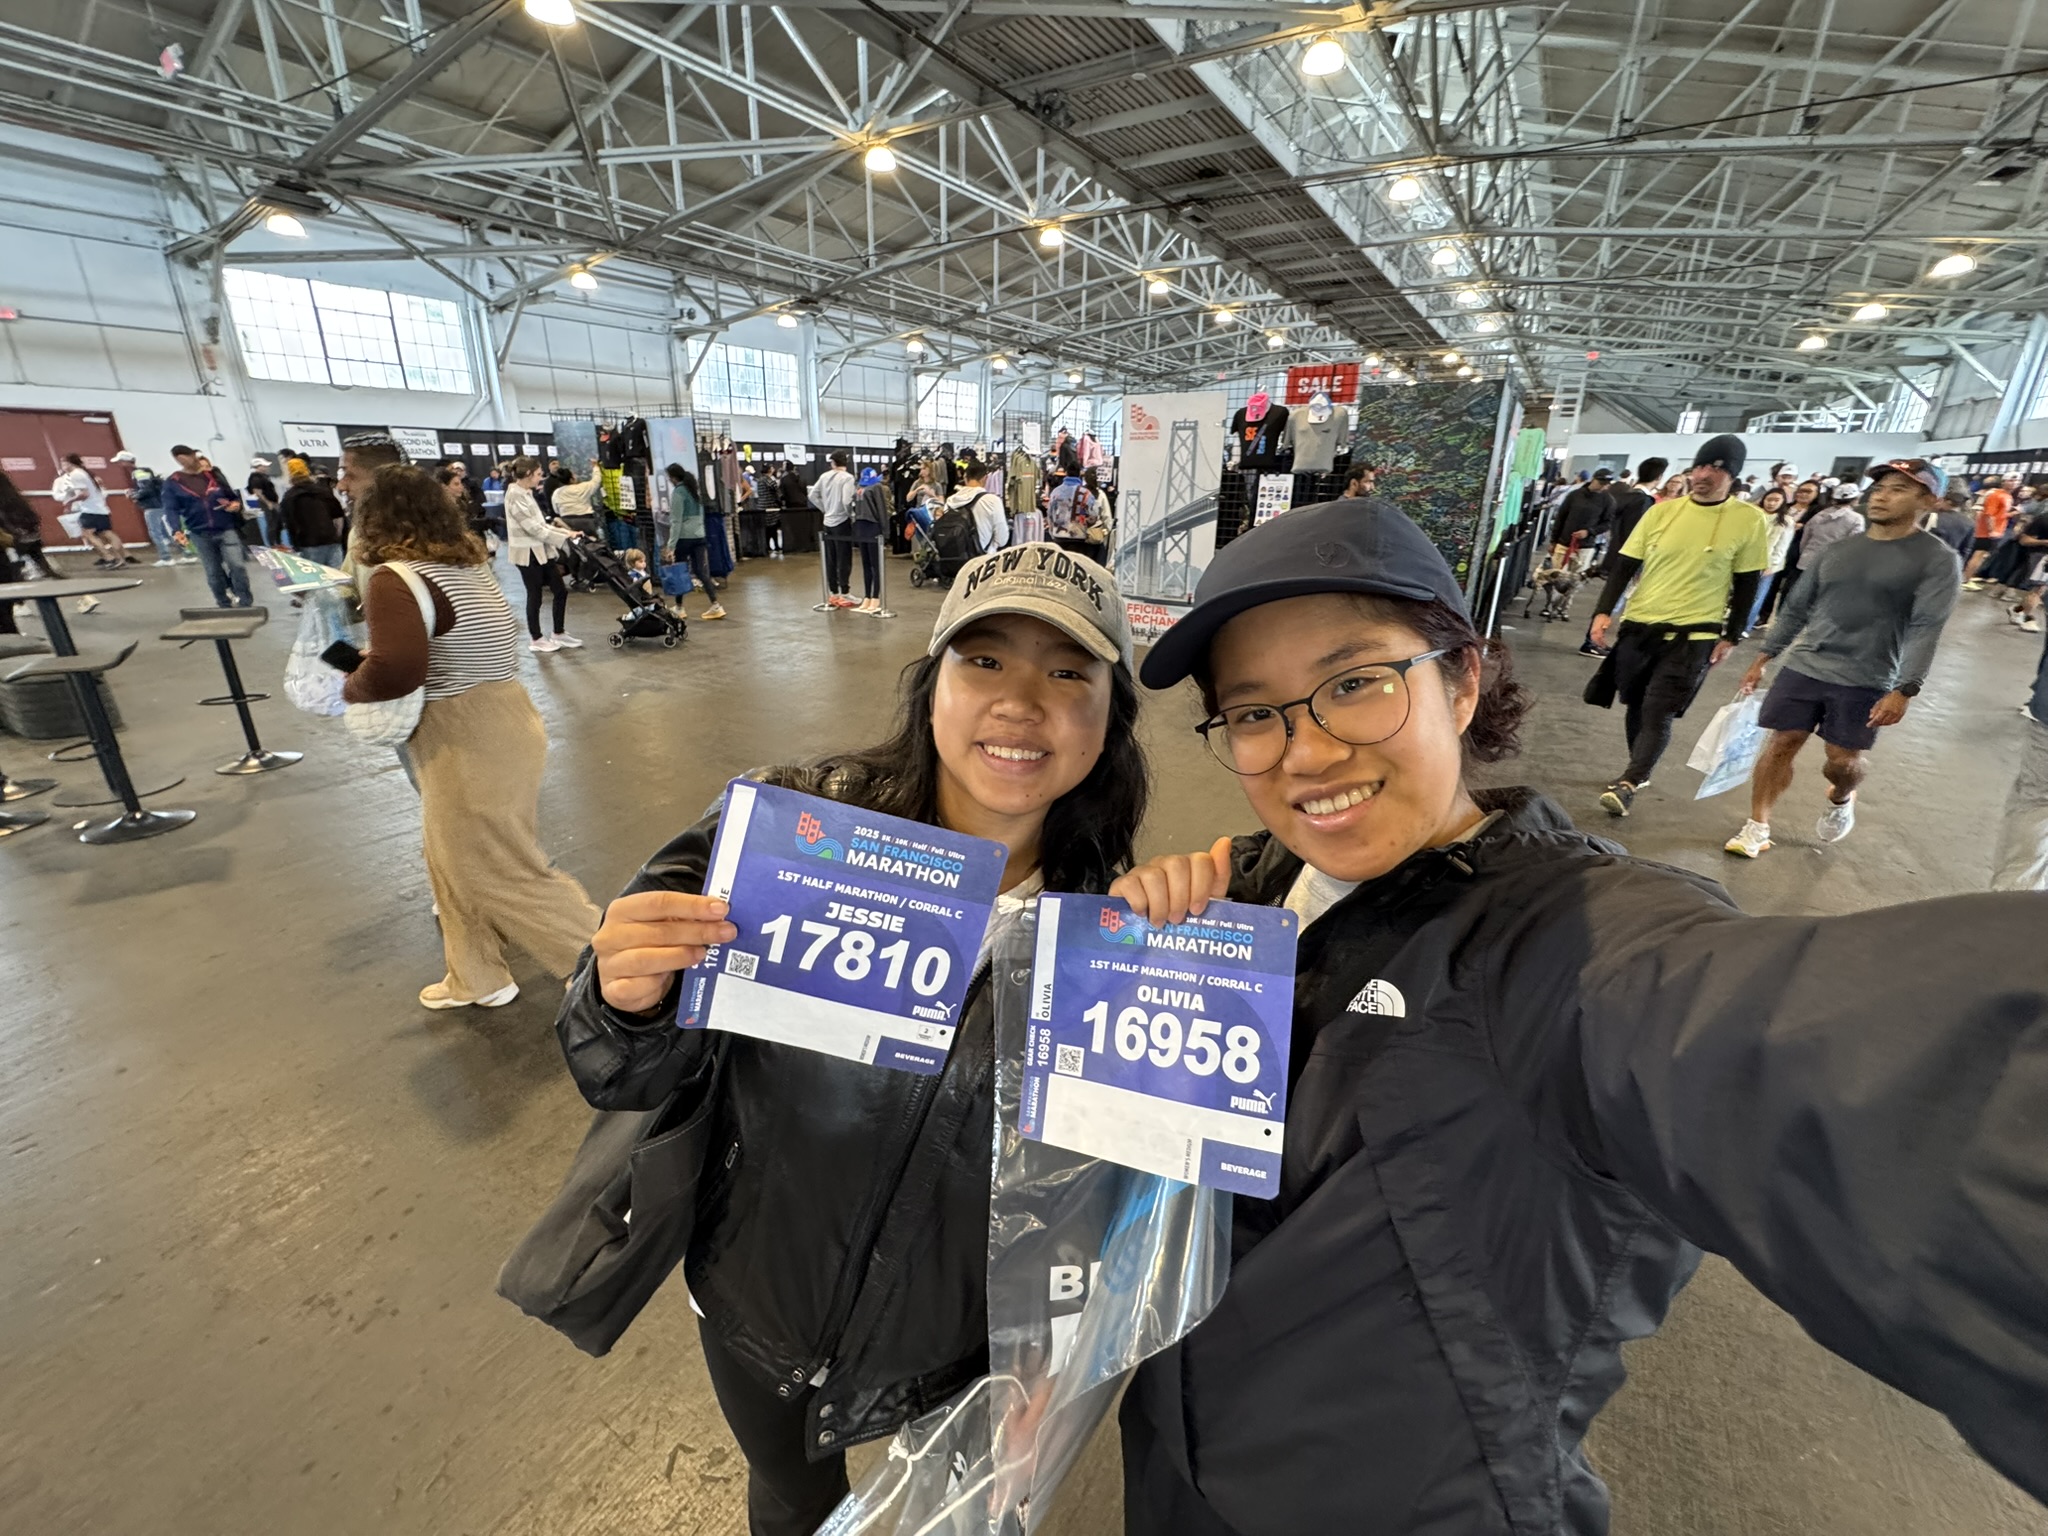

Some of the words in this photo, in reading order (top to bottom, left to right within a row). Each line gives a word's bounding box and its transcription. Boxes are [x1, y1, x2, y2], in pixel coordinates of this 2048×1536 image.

[1298, 375, 1344, 394] SALE
[406, 448, 436, 456] ARATHON
[422, 438, 436, 446] HALF
[964, 547, 1027, 599] NEW
[1036, 547, 1104, 611] YORK
[994, 574, 1038, 585] Original
[1126, 603, 1169, 616] FFICIAL
[851, 837, 880, 853] SAN
[883, 844, 963, 872] FRANCISCO
[854, 826, 880, 839] 2025
[895, 837, 908, 846] 10K
[912, 842, 928, 851] Half
[931, 846, 945, 855] Full
[948, 851, 966, 860] Ultra
[846, 849, 960, 888] MARATHON
[777, 870, 802, 883] 1ST
[802, 876, 834, 890] HALF
[834, 883, 898, 905] MARATHON
[908, 900, 953, 917] CORRAL
[954, 910, 964, 920] C
[825, 901, 906, 933] JESSIE
[1219, 920, 1232, 928] Full
[1236, 923, 1254, 931] Ultra
[1146, 933, 1252, 960] MARATHON
[1176, 924, 1254, 944] FRANCISCO
[760, 914, 951, 996] 17810
[1090, 960, 1110, 970] 1ST
[1112, 962, 1139, 973] HALF
[1140, 966, 1198, 983] MARATHON
[1207, 976, 1252, 991] CORRAL
[1254, 983, 1263, 993] C
[694, 978, 706, 1012] MARATHON
[1041, 983, 1052, 1018] OLIVIA
[1137, 984, 1205, 1012] OLIVIA
[912, 1005, 946, 1020] PUMA
[1028, 1025, 1036, 1046] CHECK
[1037, 1028, 1052, 1067] 16958
[1082, 1000, 1261, 1084] 16958
[895, 1052, 935, 1065] BEVERAGE
[1030, 1076, 1040, 1118] MARATHON
[1230, 1095, 1268, 1114] PUMA
[1220, 1162, 1267, 1179] BEVERAGE
